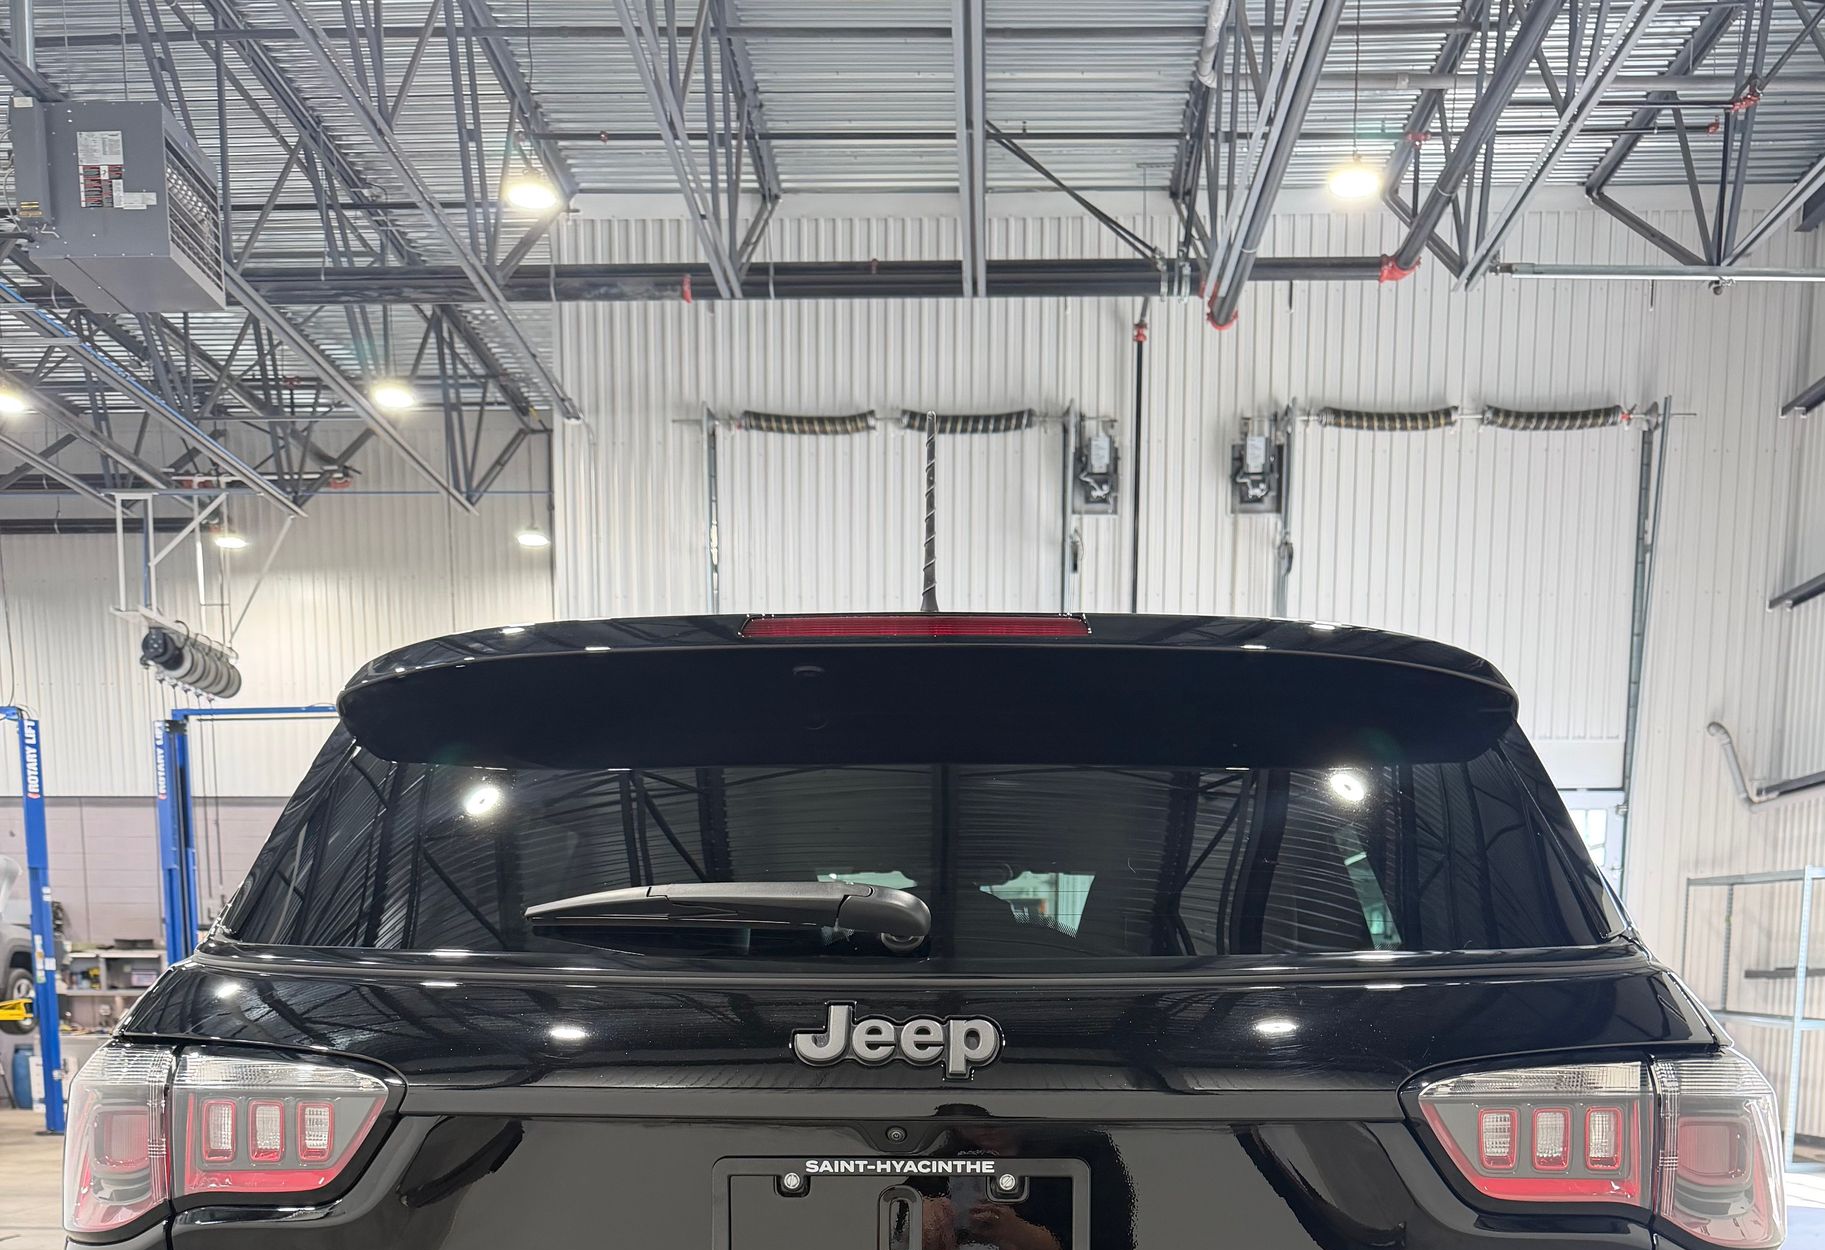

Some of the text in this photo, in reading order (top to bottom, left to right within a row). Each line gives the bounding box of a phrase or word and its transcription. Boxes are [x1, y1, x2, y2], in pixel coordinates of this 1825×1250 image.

[23, 720, 40, 793] ROTARY LIFT
[794, 1004, 1000, 1076] Jeep
[805, 1159, 996, 1174] SAINT-HYACINTHE
